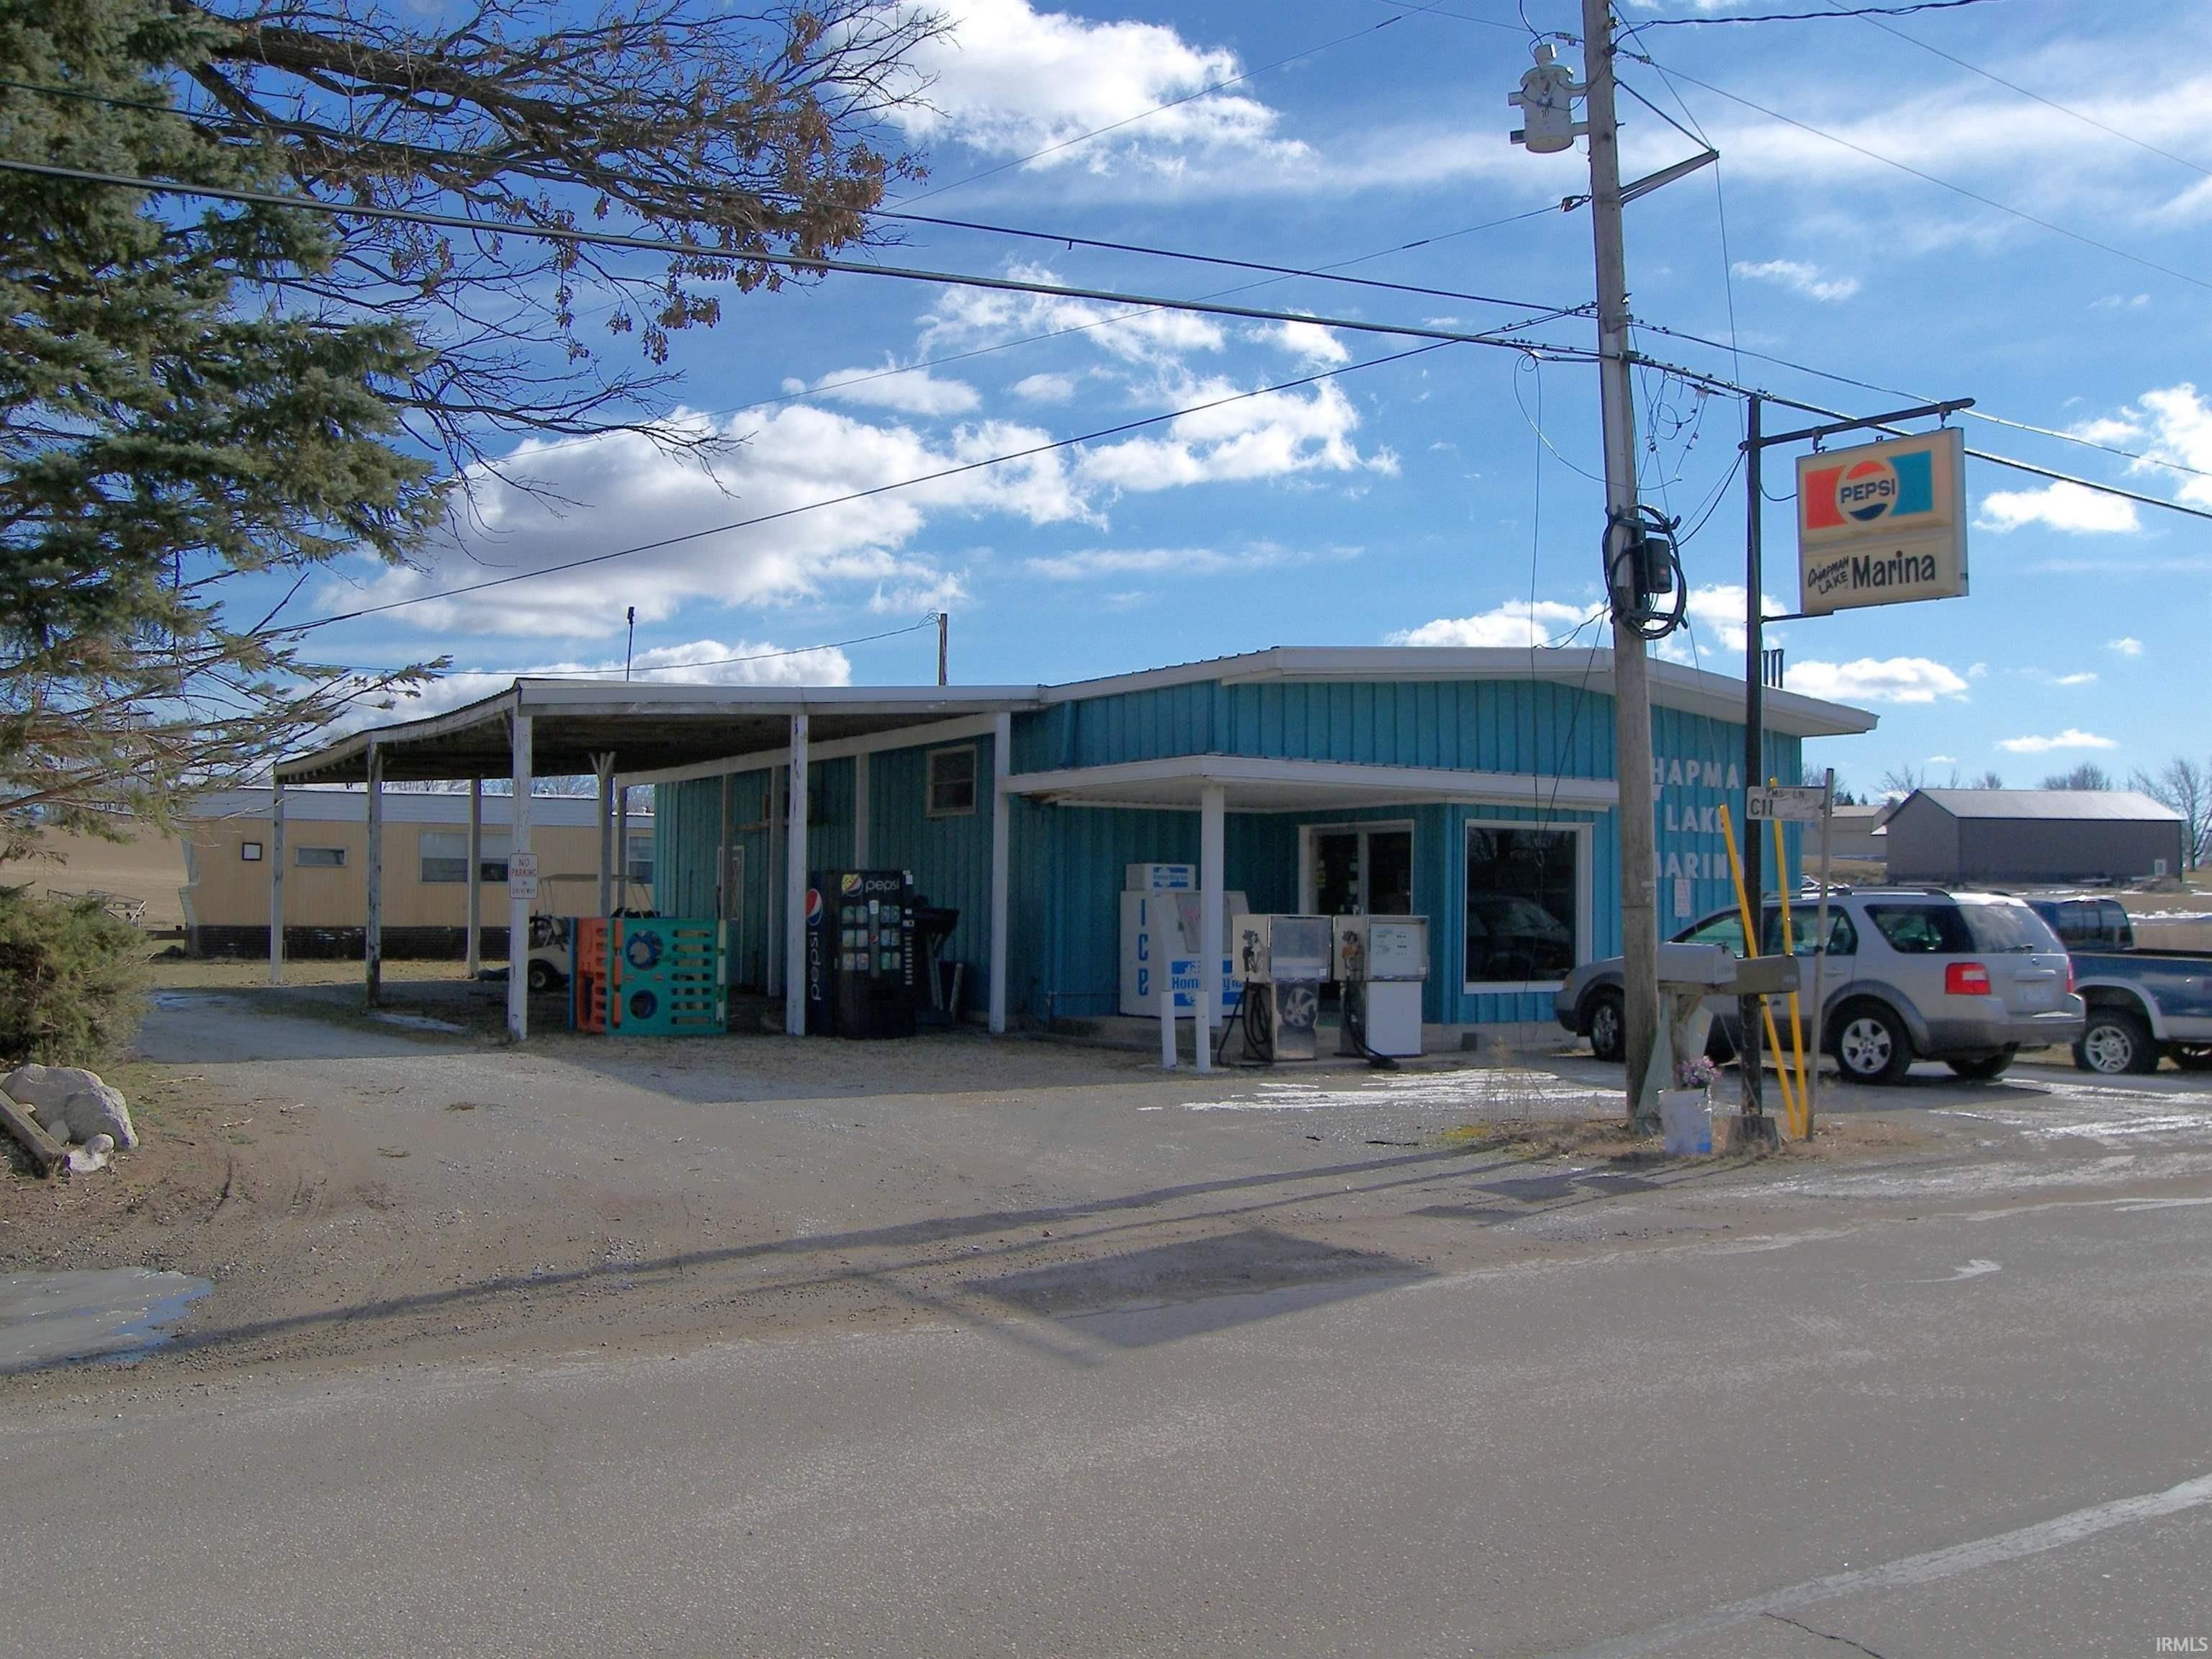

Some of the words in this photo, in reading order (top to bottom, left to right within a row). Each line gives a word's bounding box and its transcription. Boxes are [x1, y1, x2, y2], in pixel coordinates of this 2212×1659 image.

[1840, 478, 1896, 503] PEPSI
[1852, 550, 1936, 590] Marina
[1818, 572, 1848, 595] LAKE
[518, 858, 530, 867] NO
[512, 868, 536, 877] PARKING
[866, 878, 899, 893] pepsi
[809, 931, 822, 1001] pepsi
[1172, 976, 1200, 989] Hom
